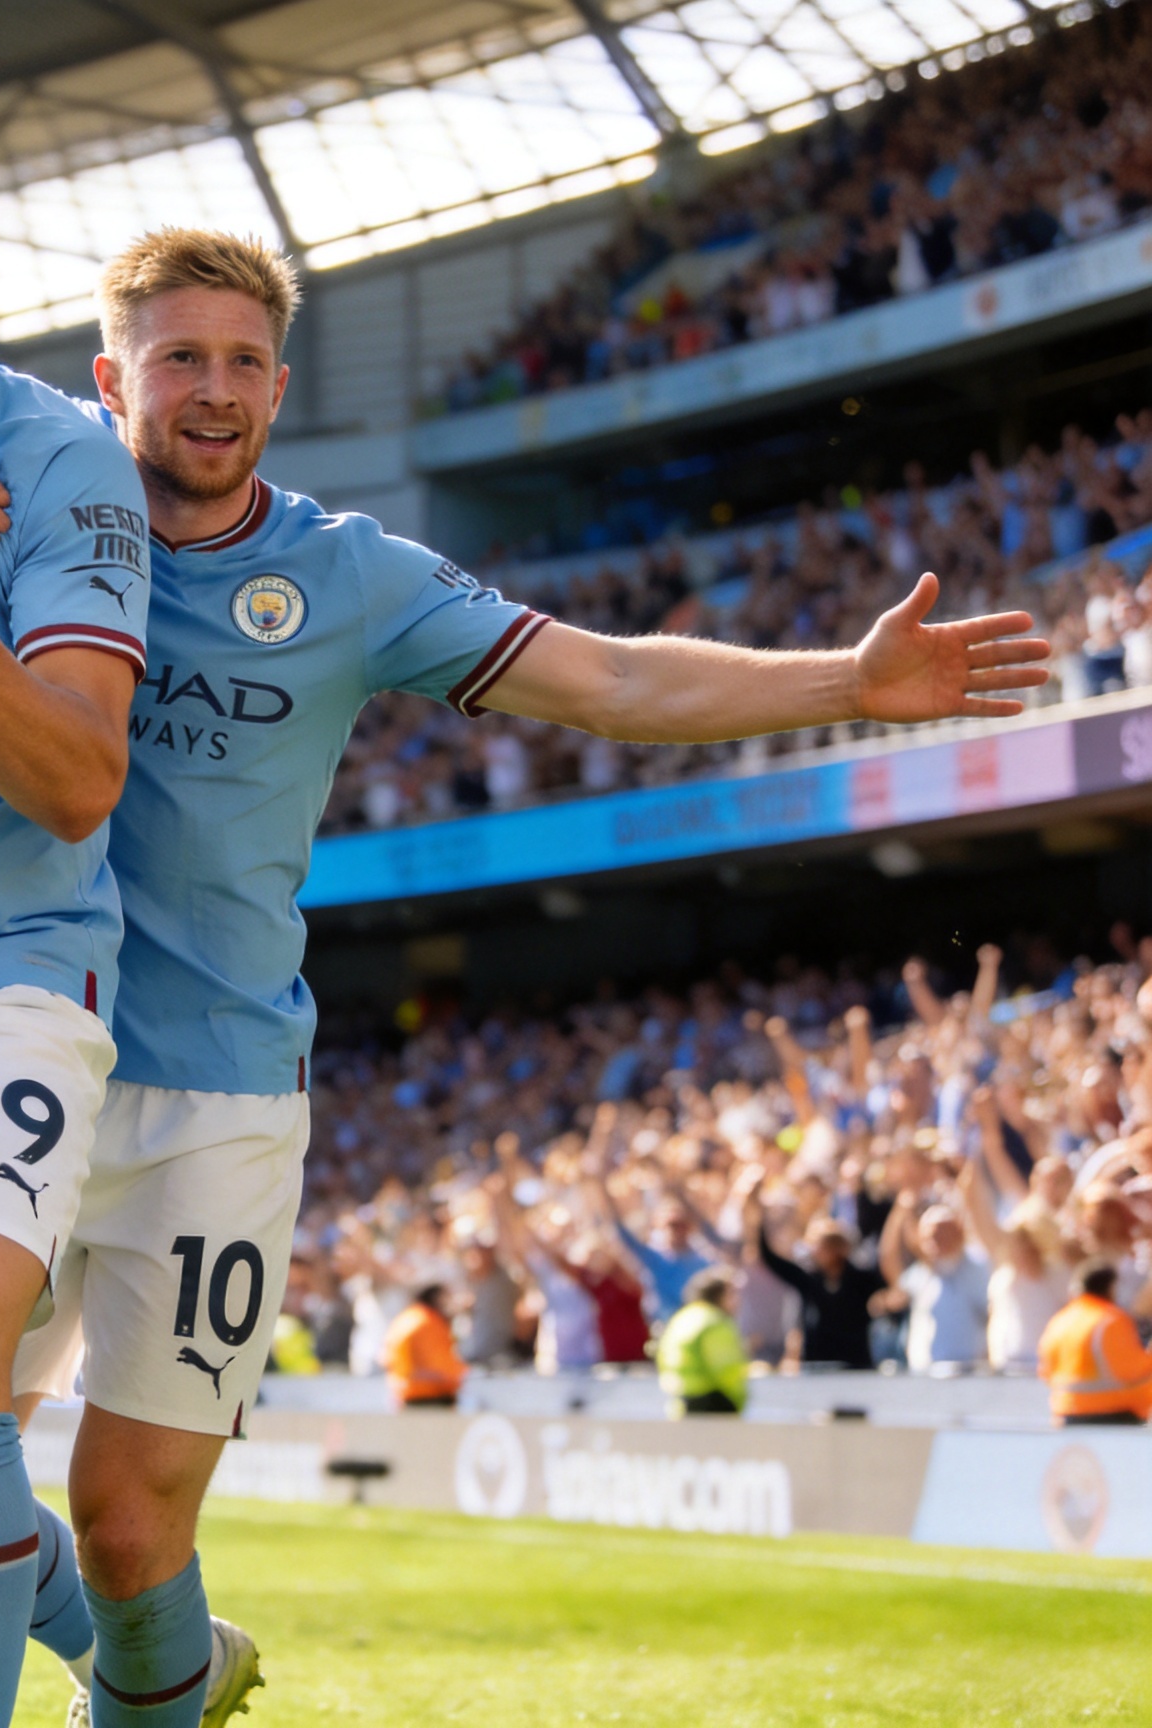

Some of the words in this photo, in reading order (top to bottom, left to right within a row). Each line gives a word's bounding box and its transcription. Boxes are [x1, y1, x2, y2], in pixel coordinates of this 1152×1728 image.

[139, 664, 294, 724] HAD
[129, 714, 230, 761] WAYS
[1, 1078, 65, 1165] 9
[170, 1235, 264, 1347] 10
